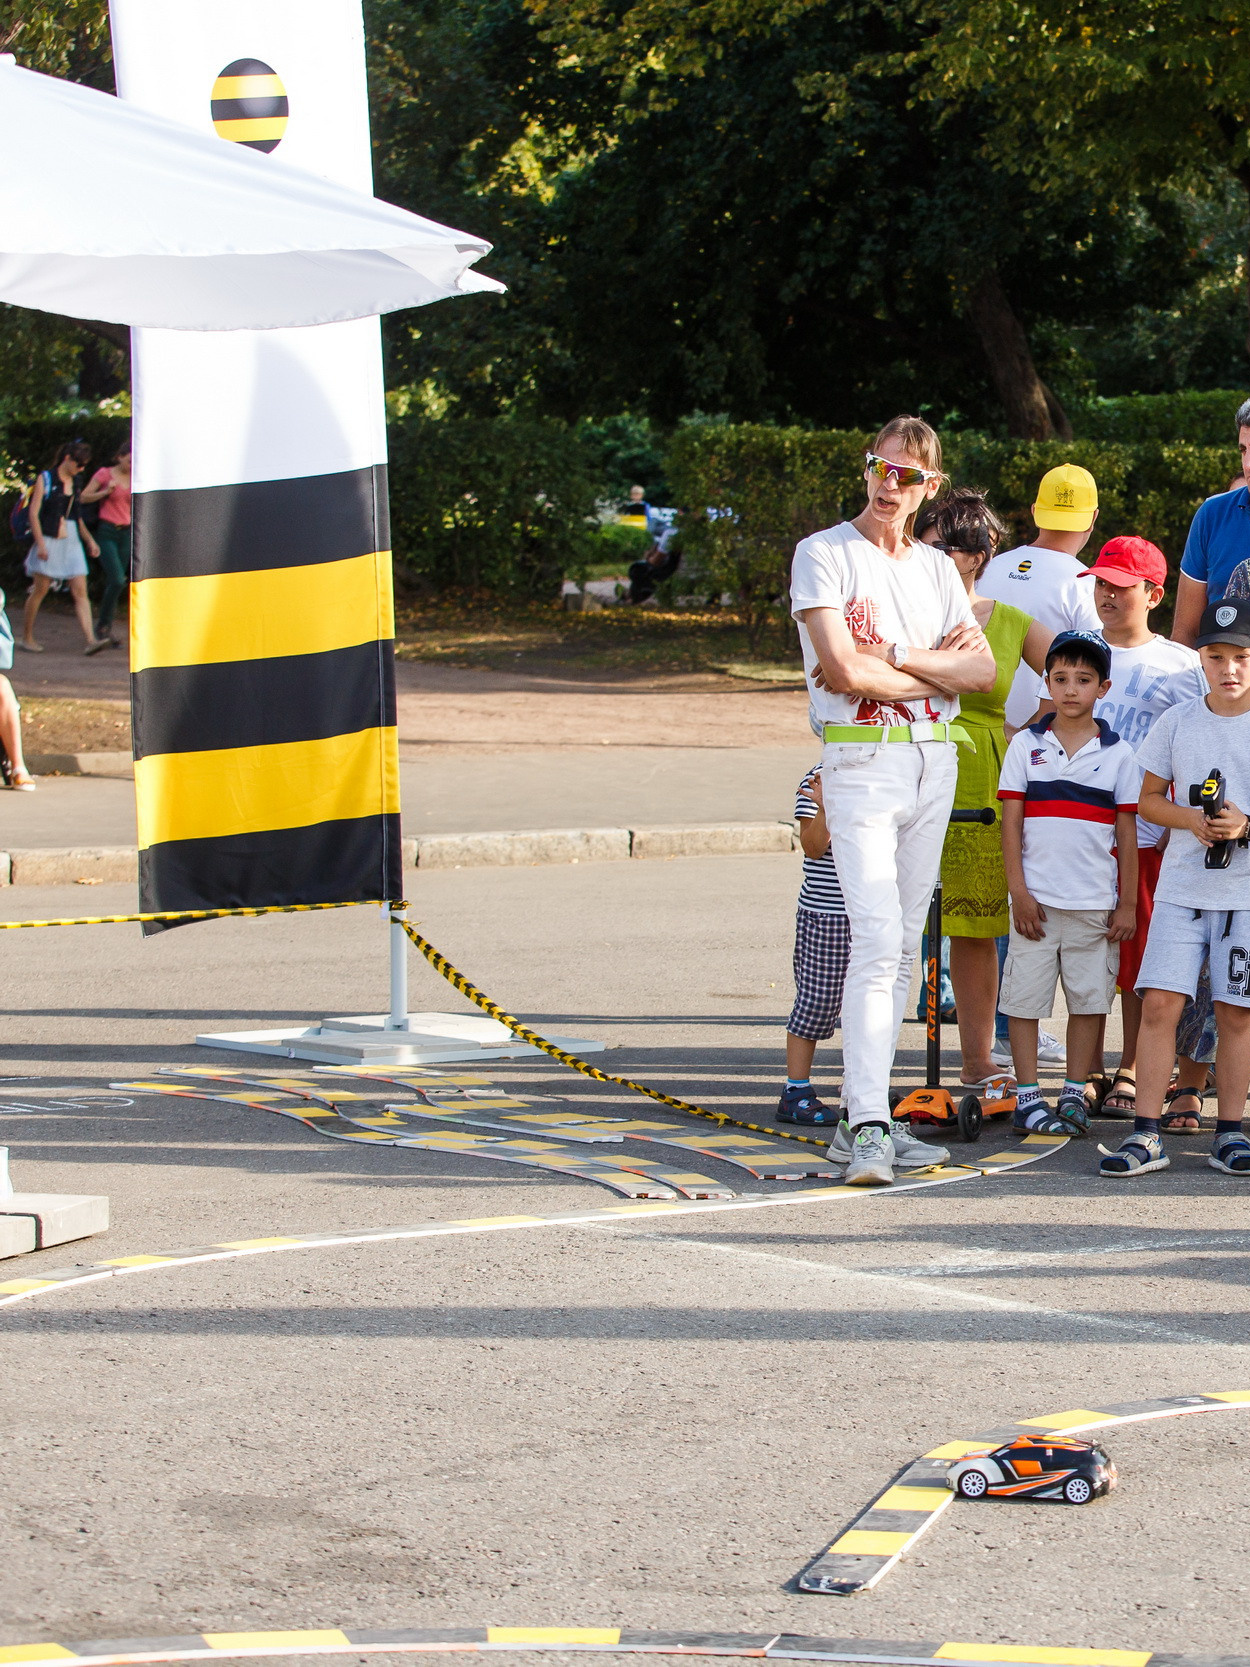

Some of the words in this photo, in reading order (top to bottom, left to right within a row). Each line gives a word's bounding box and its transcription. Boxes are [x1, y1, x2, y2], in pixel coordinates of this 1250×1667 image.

[1124, 662, 1170, 702] 17
[1093, 701, 1155, 744] СИЯ
[1201, 779, 1218, 796] 5
[926, 955, 937, 1042] KREISS
